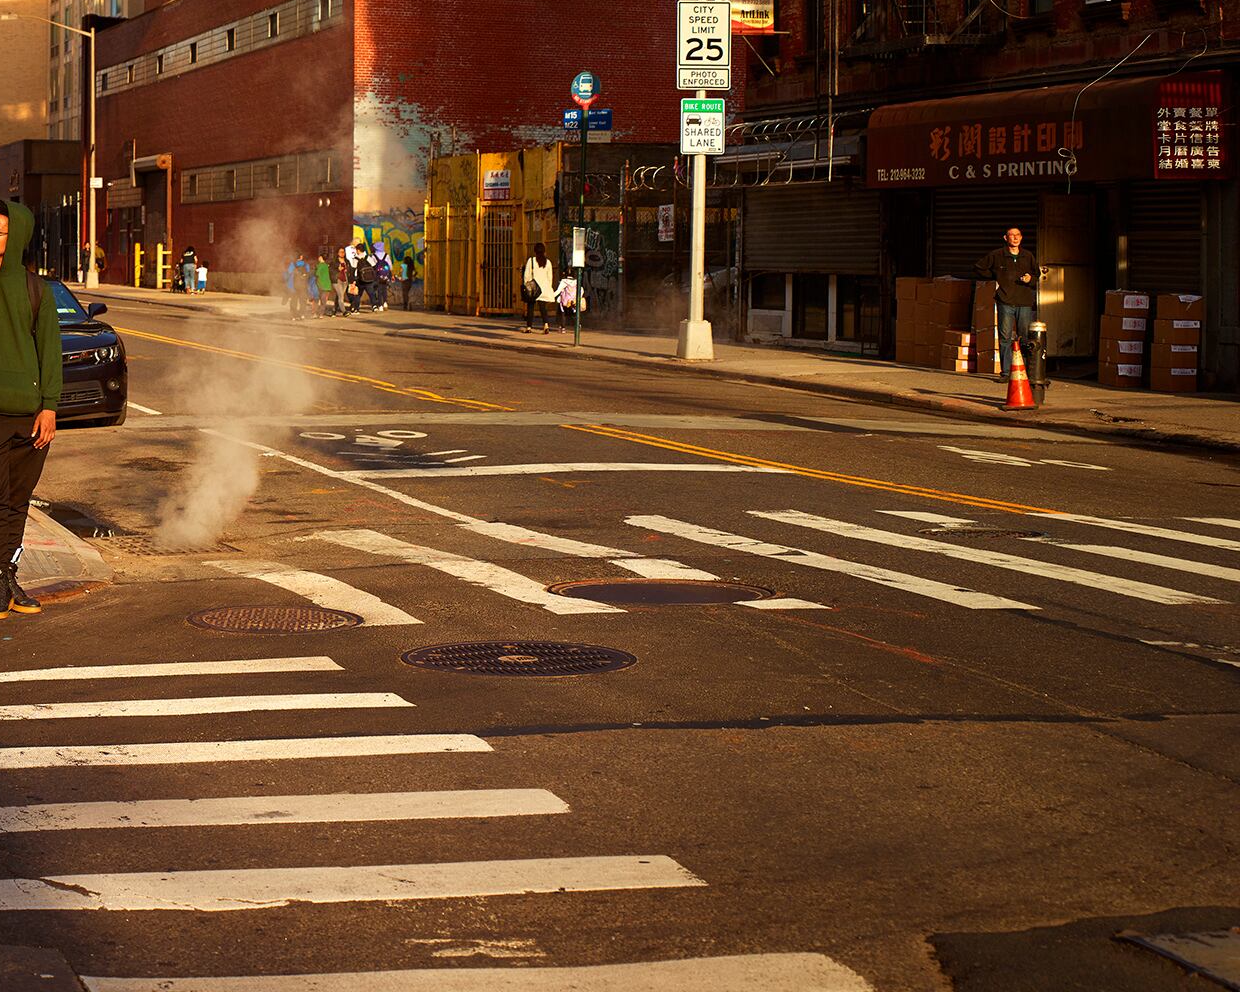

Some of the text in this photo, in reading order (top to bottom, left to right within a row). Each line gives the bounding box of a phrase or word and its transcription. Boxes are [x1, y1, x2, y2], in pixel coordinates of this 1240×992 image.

[693, 5, 714, 14] CITY
[688, 15, 719, 24] SPEED
[691, 26, 716, 34] LIMIT
[685, 37, 724, 61] 25
[682, 78, 726, 86] ENFORCED
[684, 103, 722, 111] BIKE ROUTE
[564, 111, 578, 119] M15
[564, 121, 579, 129] M22
[684, 127, 722, 137] SHARED
[1156, 132, 1220, 144] 卡片信封
[689, 138, 716, 148] LANE
[948, 160, 1078, 180] C & S PRINTING
[877, 169, 889, 182] TEL:
